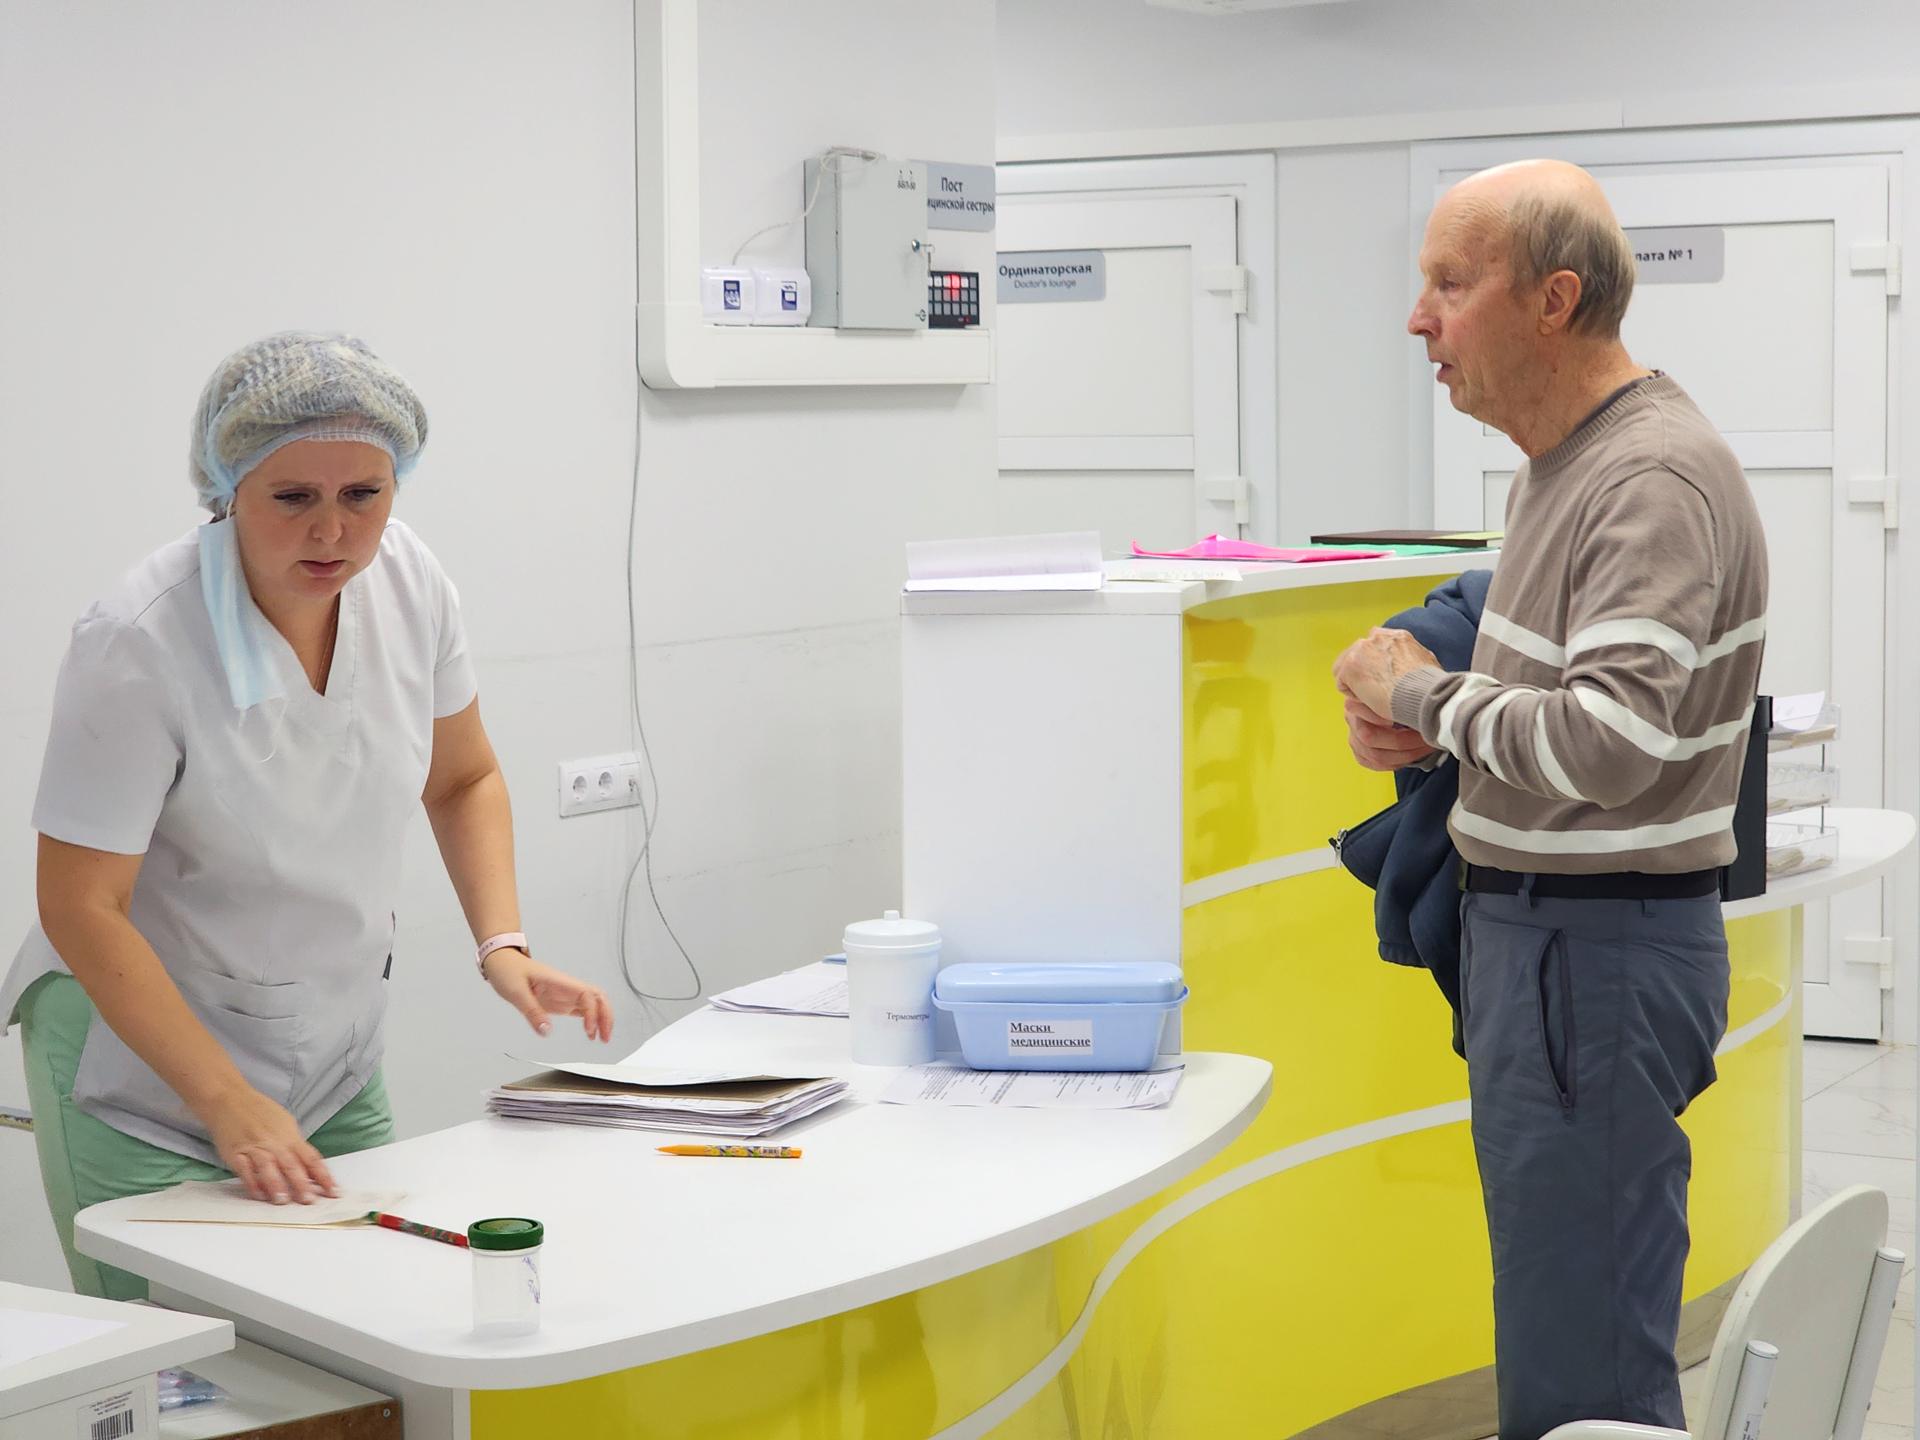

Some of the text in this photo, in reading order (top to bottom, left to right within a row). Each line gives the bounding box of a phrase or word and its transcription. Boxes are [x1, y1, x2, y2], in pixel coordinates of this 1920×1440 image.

[941, 177, 963, 192] Пост
[966, 201, 995, 215] сестры
[1635, 251, 1665, 262] лата
[1687, 249, 1693, 260] 1
[999, 265, 1093, 279] Ординаторская
[1014, 279, 1077, 289] Doctor's lounge
[1010, 1022, 1051, 1034] Маски
[1010, 1038, 1091, 1048] медицинские
